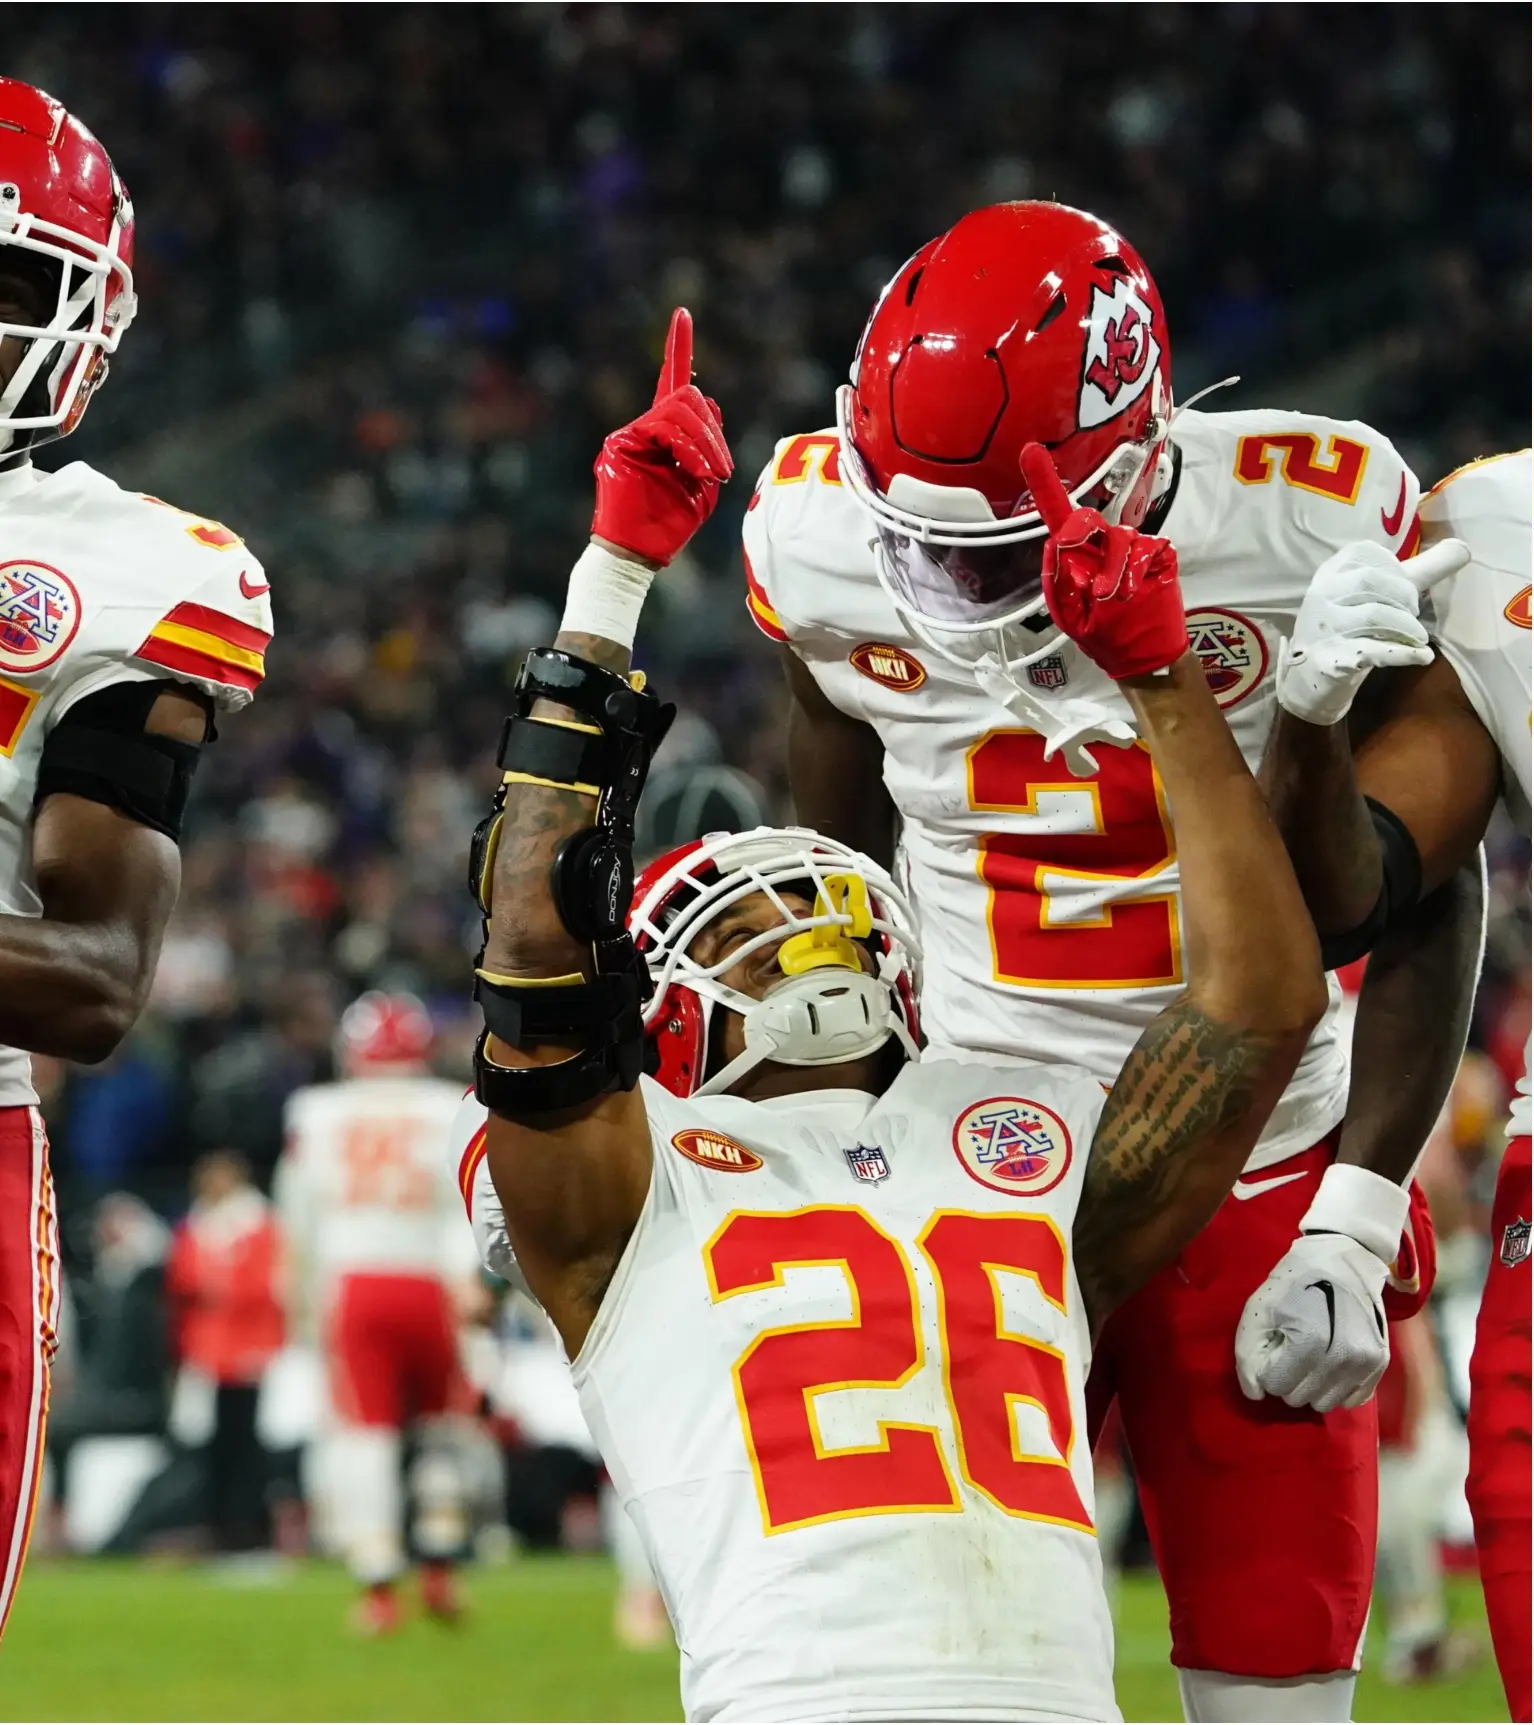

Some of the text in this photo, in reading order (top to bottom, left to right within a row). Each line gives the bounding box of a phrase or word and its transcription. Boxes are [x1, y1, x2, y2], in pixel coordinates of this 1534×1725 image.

[1233, 432, 1370, 506] 2
[866, 653, 910, 681] NKH
[1033, 668, 1066, 689] NFL
[966, 727, 1188, 989] 2
[608, 852, 622, 923] DONJOY
[694, 1136, 743, 1165] NKH
[855, 1161, 886, 1178] NFL
[701, 1203, 1098, 1538] 26
